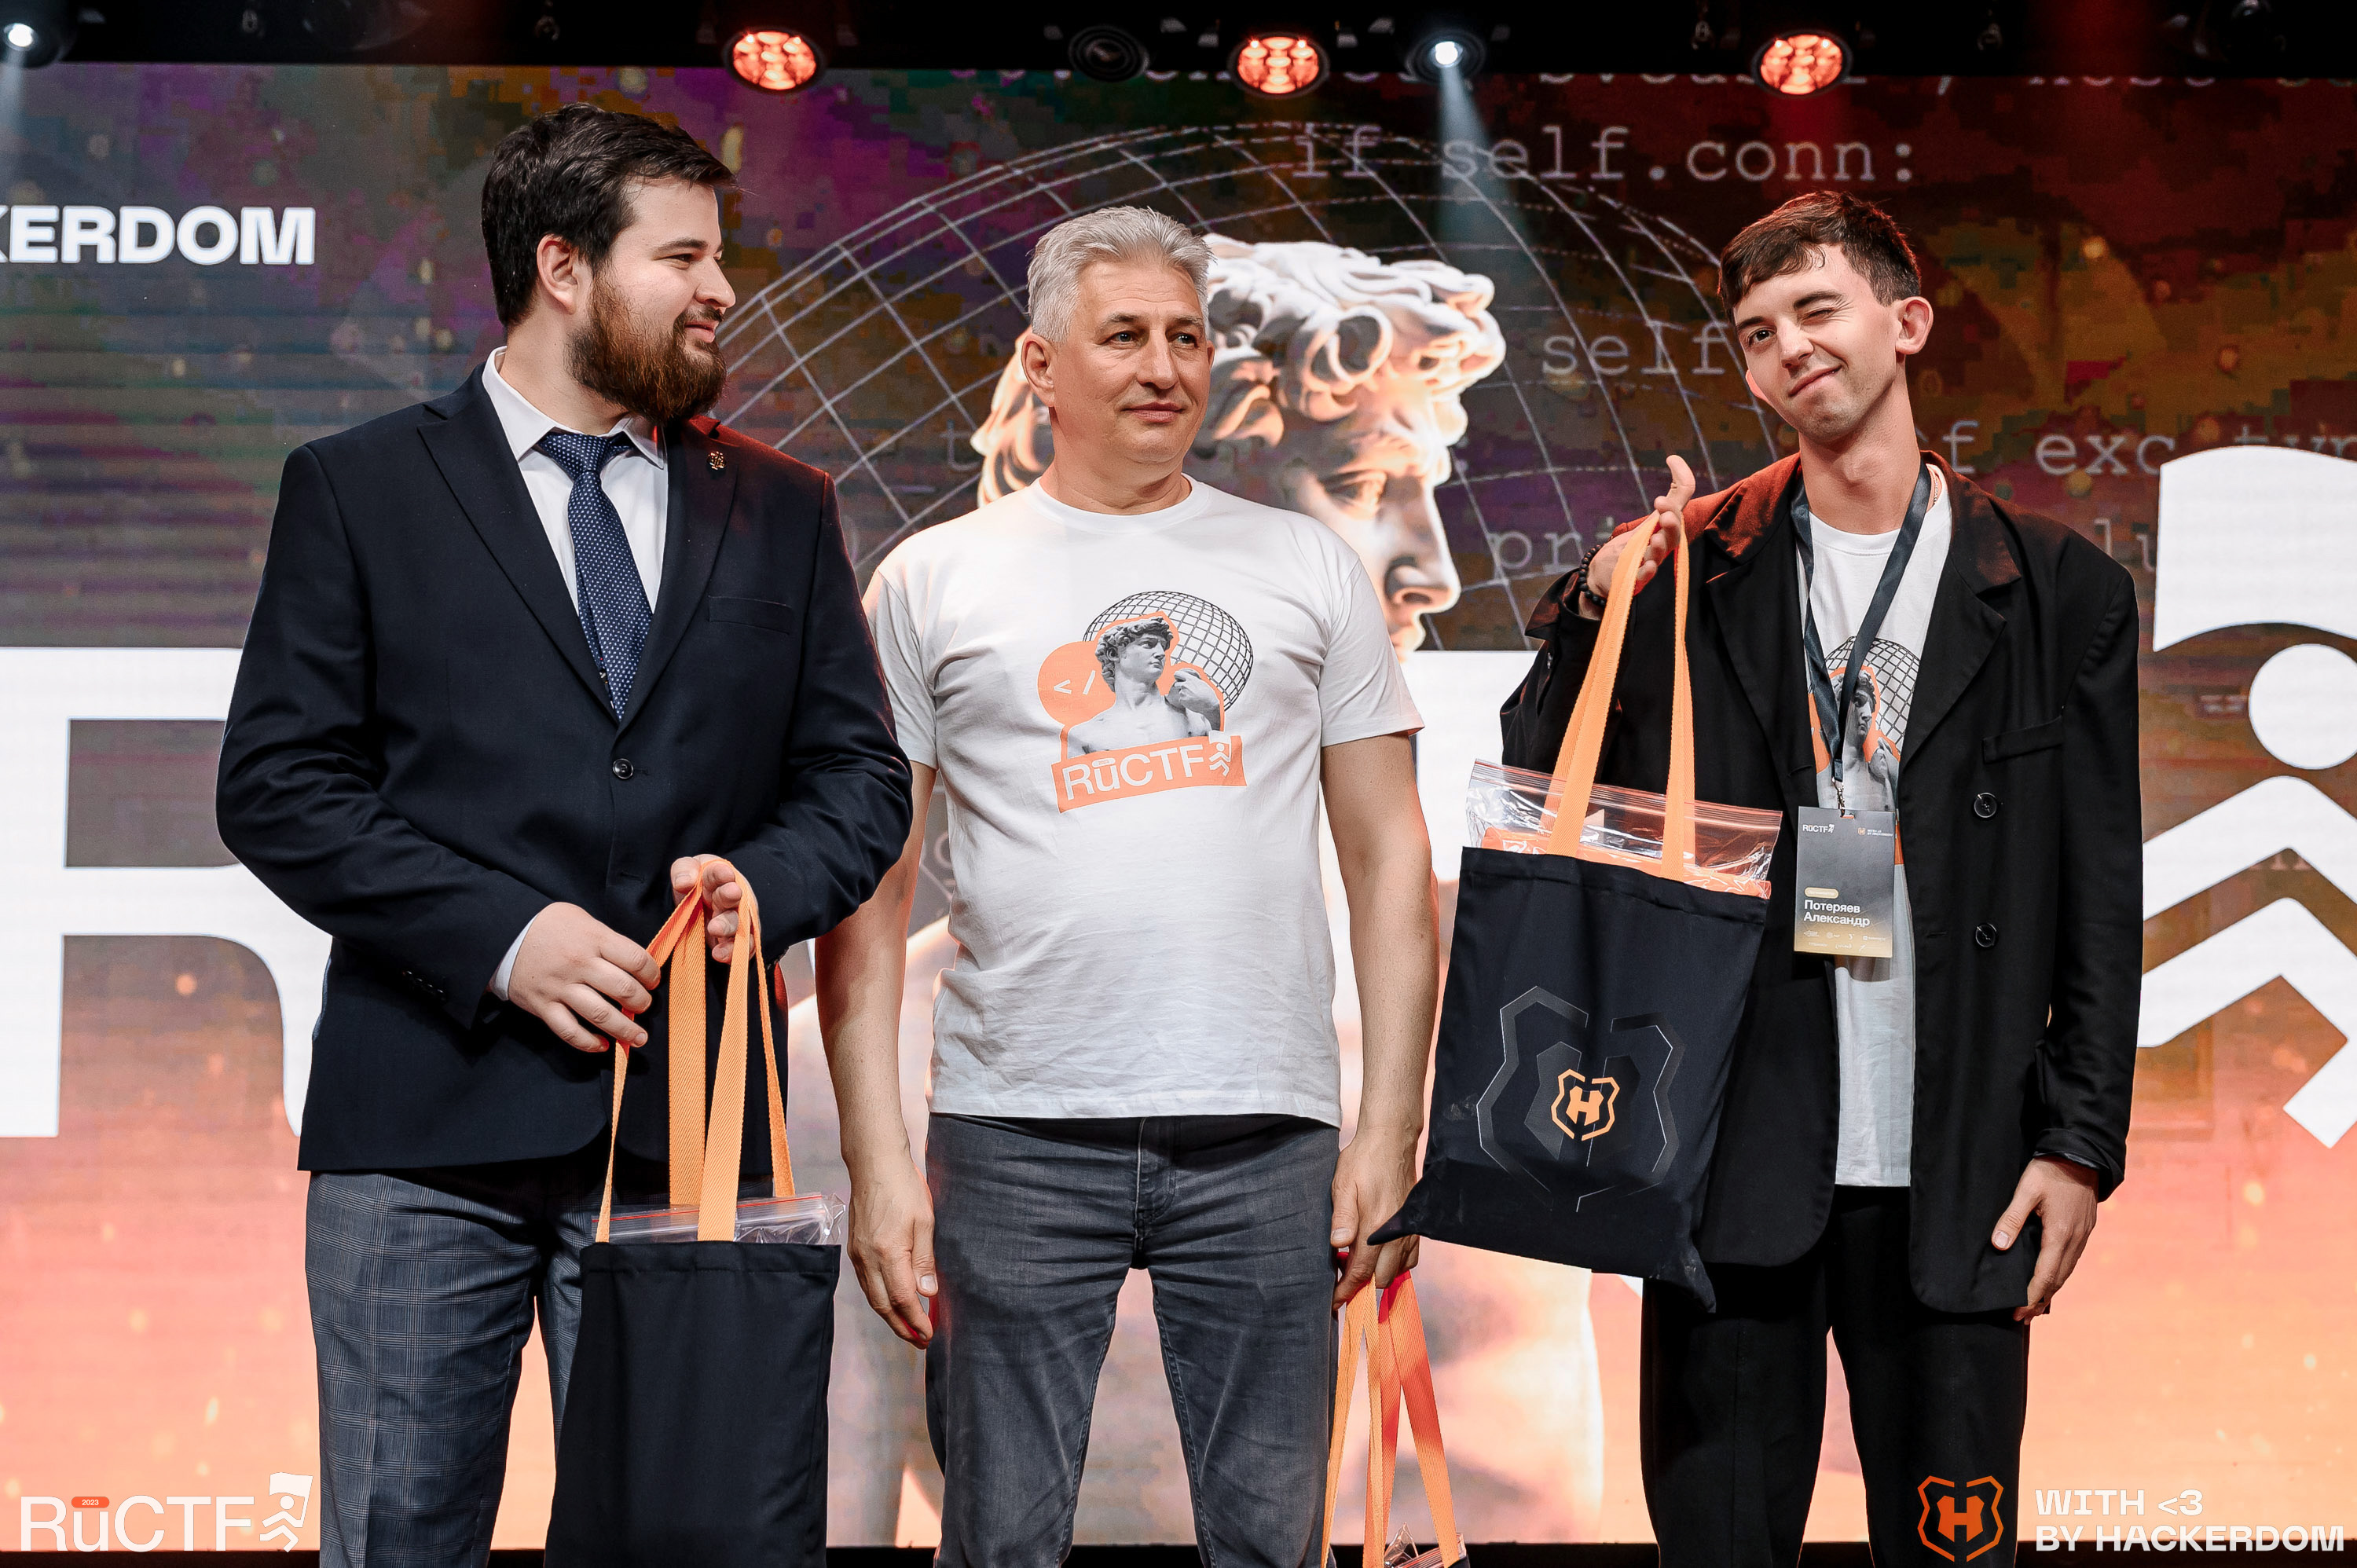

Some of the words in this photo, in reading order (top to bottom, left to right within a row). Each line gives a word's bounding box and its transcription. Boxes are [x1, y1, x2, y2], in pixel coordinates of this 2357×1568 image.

[0, 205, 316, 265] ERDOM
[1804, 899, 1861, 914] Потеряев
[1803, 911, 1871, 928] Александр
